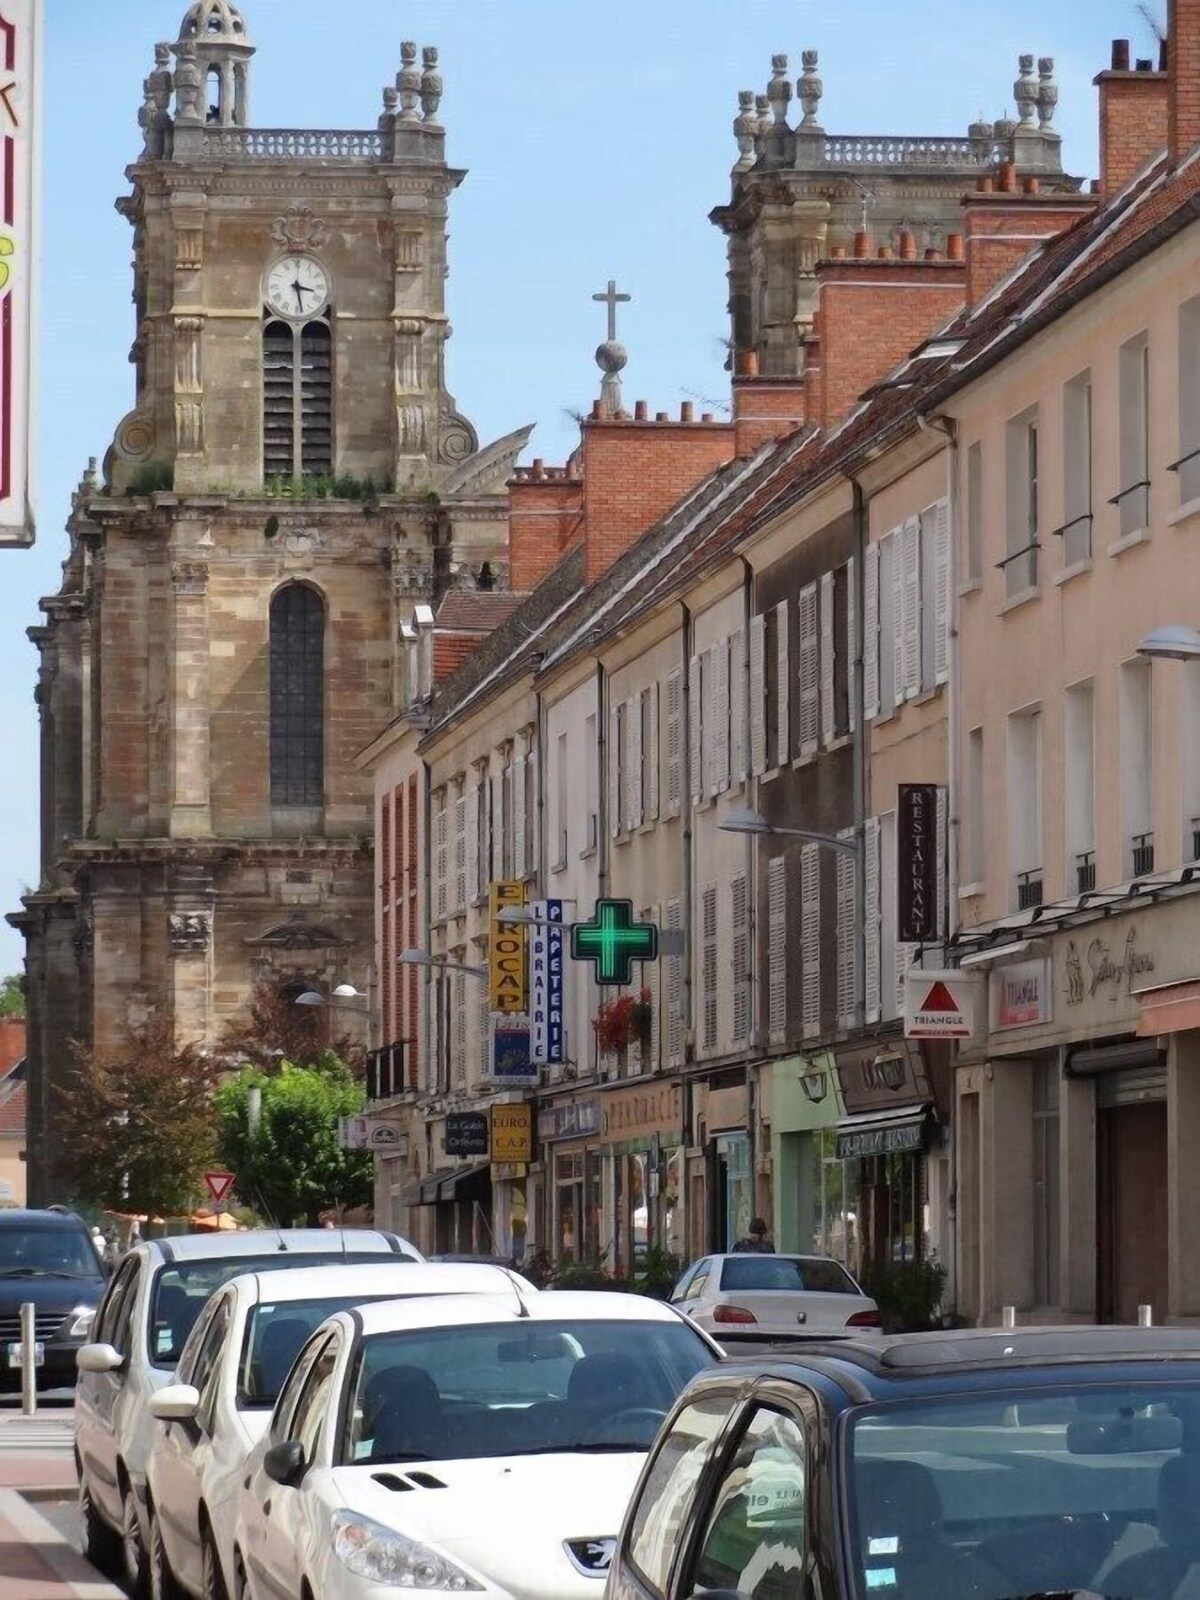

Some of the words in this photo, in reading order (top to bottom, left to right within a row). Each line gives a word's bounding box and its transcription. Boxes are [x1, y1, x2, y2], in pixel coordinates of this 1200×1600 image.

[911, 792, 925, 934] RESTAURANT
[496, 885, 520, 1008] EROCAP
[534, 906, 544, 1057] LIBRAIRIE
[549, 905, 561, 1058] PAPETERIE
[913, 1016, 963, 1025] TRIANGLE
